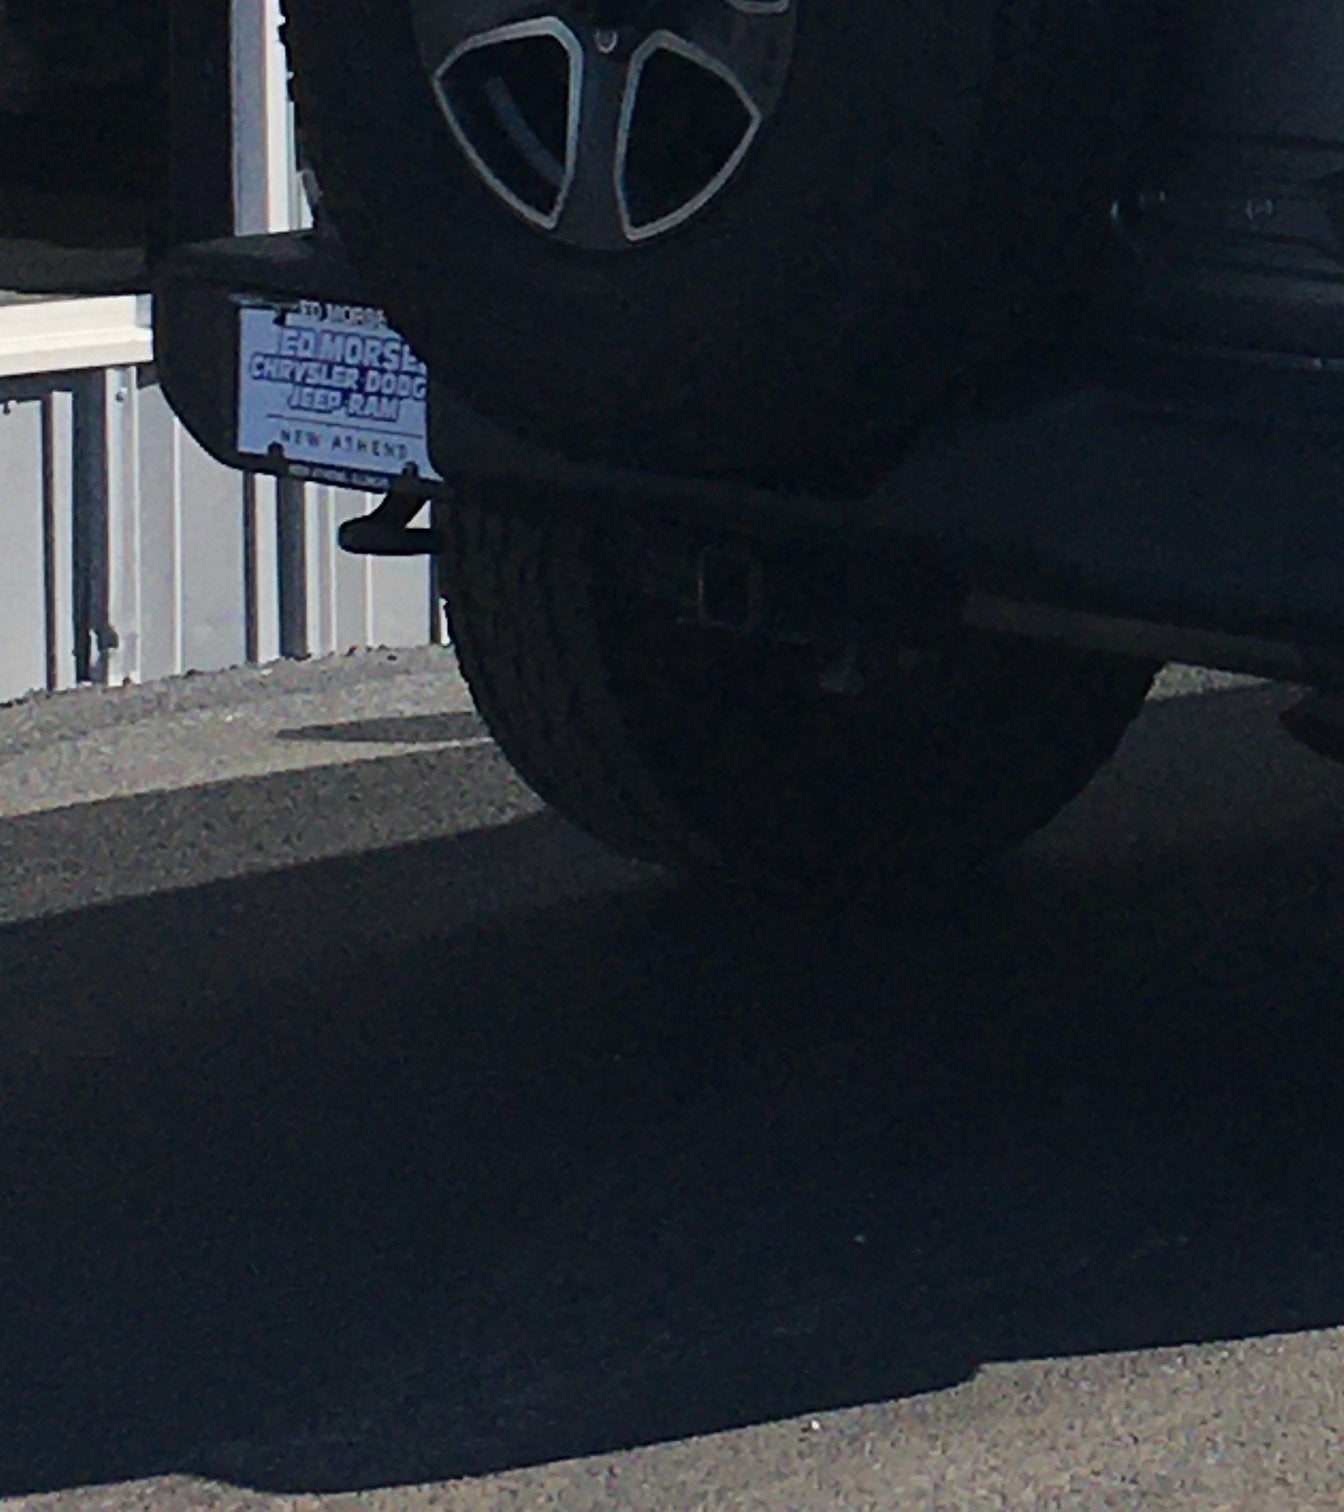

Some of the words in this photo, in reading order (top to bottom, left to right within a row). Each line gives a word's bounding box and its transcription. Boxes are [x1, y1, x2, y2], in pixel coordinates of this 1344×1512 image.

[279, 327, 317, 358] ED
[250, 355, 360, 391] CHRYSLER
[363, 369, 427, 401] DODG
[289, 385, 343, 413] JEEP
[348, 392, 400, 421] RAM
[280, 429, 321, 448] NEW
